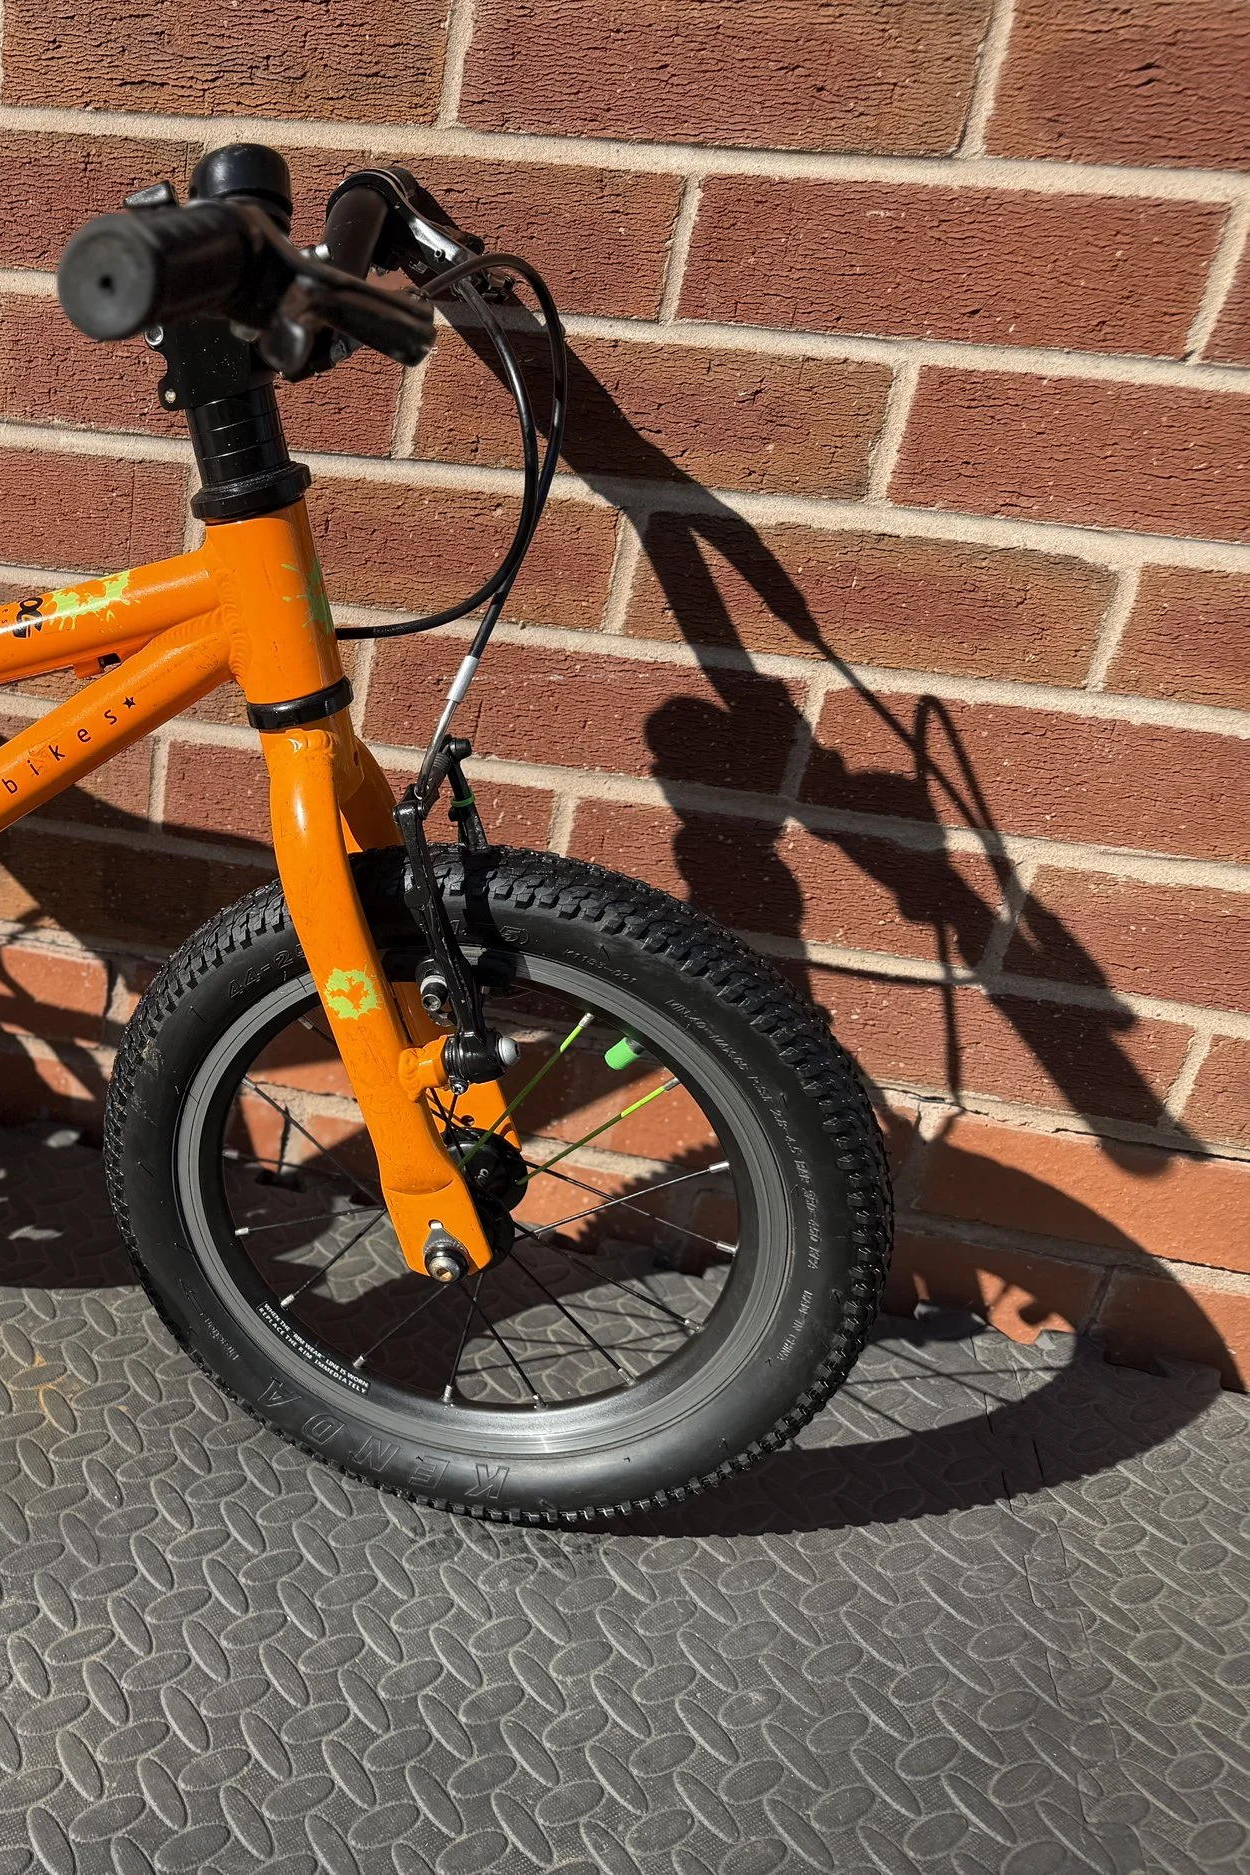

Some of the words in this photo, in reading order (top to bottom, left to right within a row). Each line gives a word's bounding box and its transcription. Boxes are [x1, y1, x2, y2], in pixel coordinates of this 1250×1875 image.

[1, 708, 118, 795] bikes
[258, 1307, 286, 1336] REPLACE
[285, 1334, 298, 1348] THE
[298, 1346, 313, 1360] RIM
[314, 1359, 367, 1394] IMMEDIATELY
[264, 1303, 281, 1321] WHEN
[279, 1320, 291, 1332] THE
[325, 1358, 340, 1371] LINE
[339, 1368, 347, 1376] IS
[347, 1372, 369, 1388] WORN
[257, 1376, 510, 1499] KENDA
